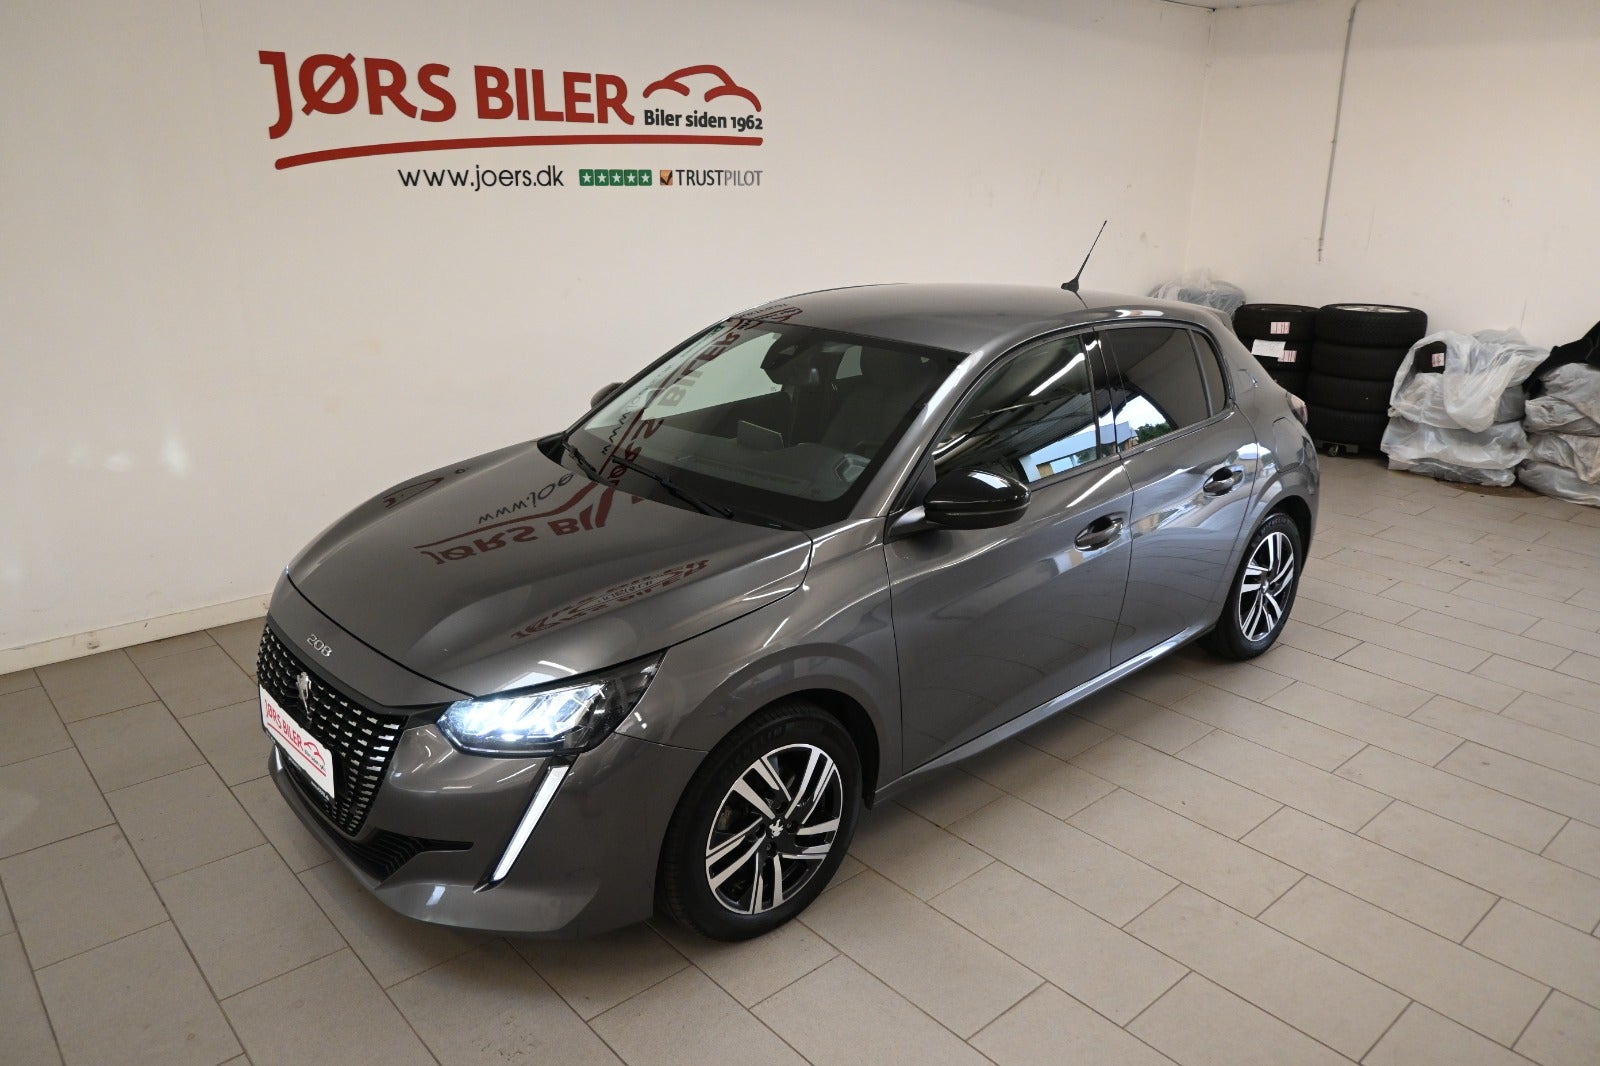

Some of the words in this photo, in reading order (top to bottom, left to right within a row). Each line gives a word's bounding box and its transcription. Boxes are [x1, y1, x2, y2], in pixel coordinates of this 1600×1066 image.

[258, 50, 457, 140] JØRS
[474, 65, 635, 126] BILER
[644, 108, 683, 127] Biler
[685, 110, 728, 129] siden
[731, 115, 764, 132] 1962
[397, 165, 565, 192] www.joers.dk
[676, 170, 764, 187] TRUSTPILOT
[306, 633, 332, 657] 208
[282, 721, 304, 752] BILER
